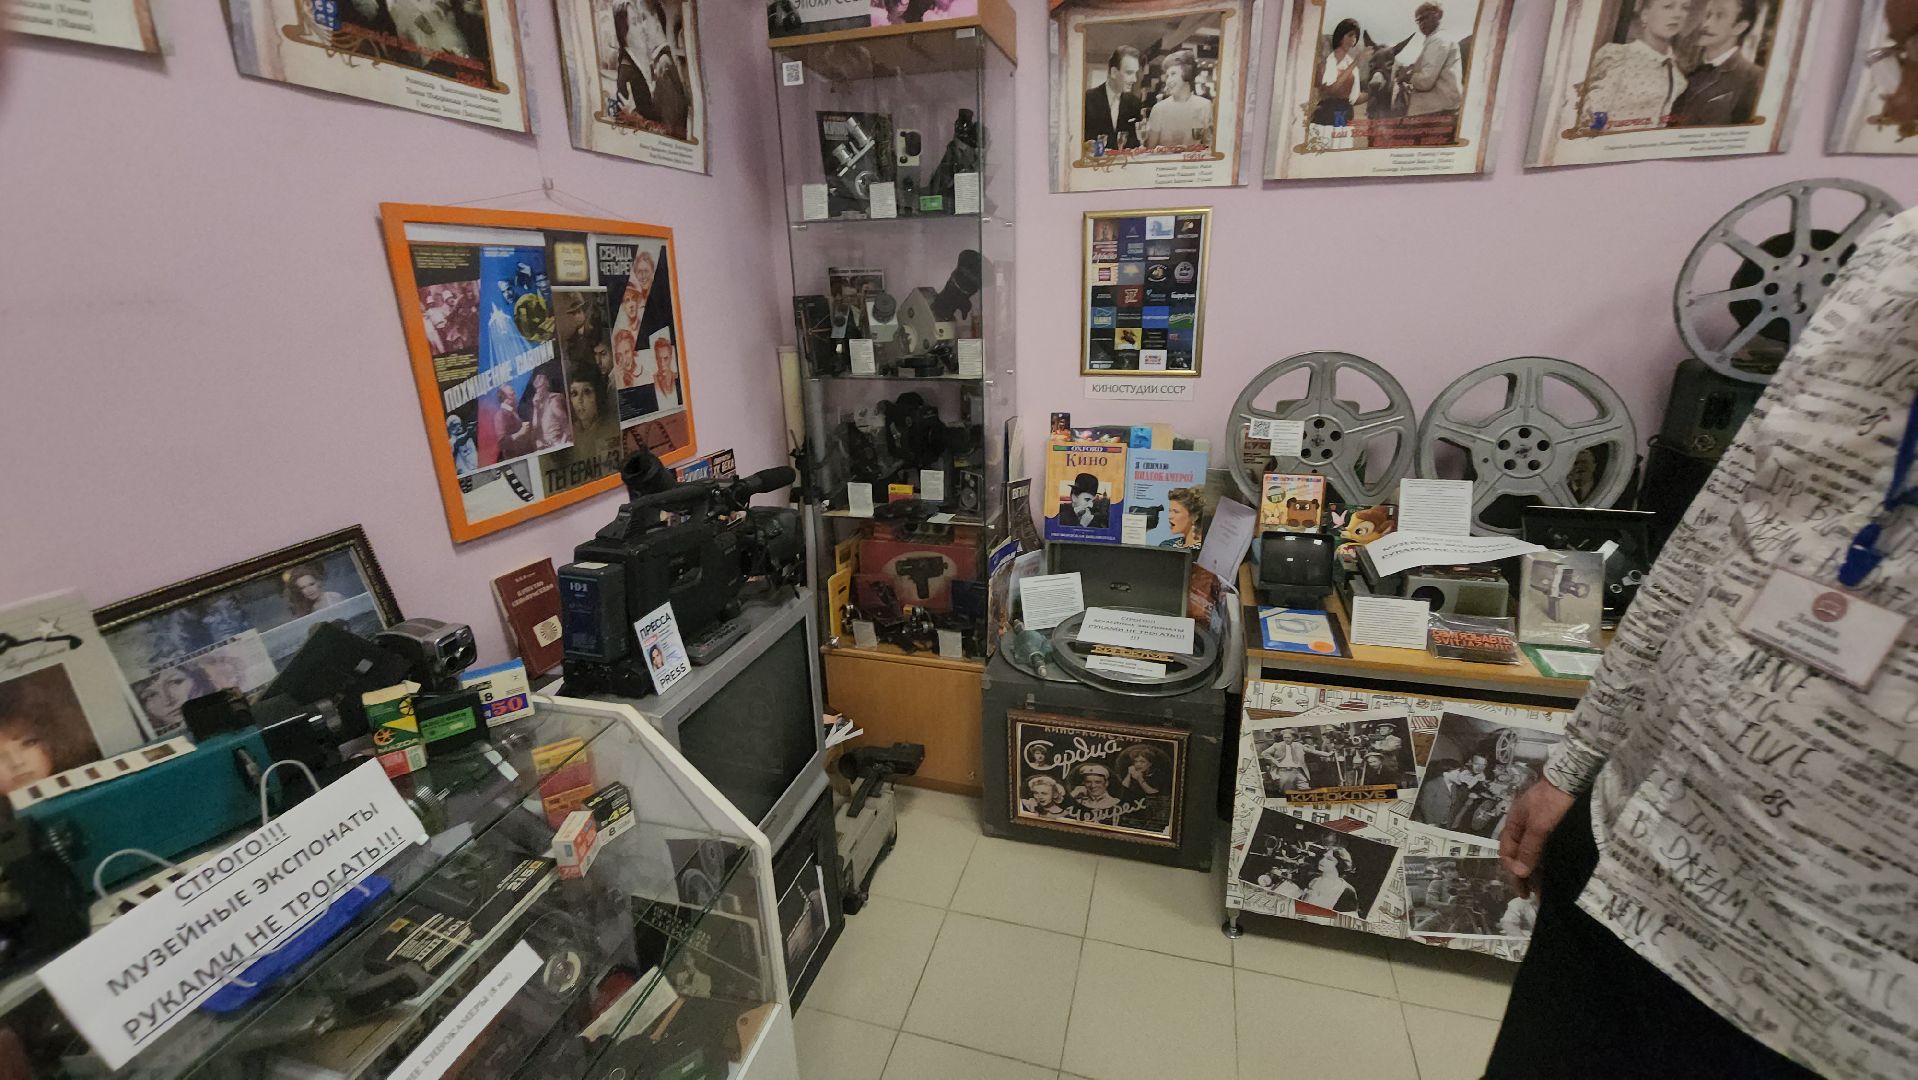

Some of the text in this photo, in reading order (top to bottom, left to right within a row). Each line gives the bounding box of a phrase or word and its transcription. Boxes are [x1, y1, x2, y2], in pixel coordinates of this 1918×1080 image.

[1092, 384, 1187, 395] КИНОСТУДИИ СССР
[1066, 454, 1108, 468] Кино
[639, 612, 672, 638] ПРЕССА
[660, 663, 687, 688] PRESS
[484, 692, 493, 701] 8
[491, 695, 524, 717] 50
[1023, 736, 1122, 780] Сердца
[1291, 788, 1389, 802] КИНОКЛУБ
[608, 805, 631, 822] 45
[174, 821, 287, 901] СТРОГО!!!
[106, 801, 380, 997] МУЗЕЙНЫЕ ЭКСПОНАТЫ
[121, 943, 245, 1042] РУКАМИ
[244, 914, 283, 949] НЕ
[280, 825, 404, 922] ТРОГАТЬ!!!
[422, 995, 488, 1067] КИНОКАМЕРЫ
